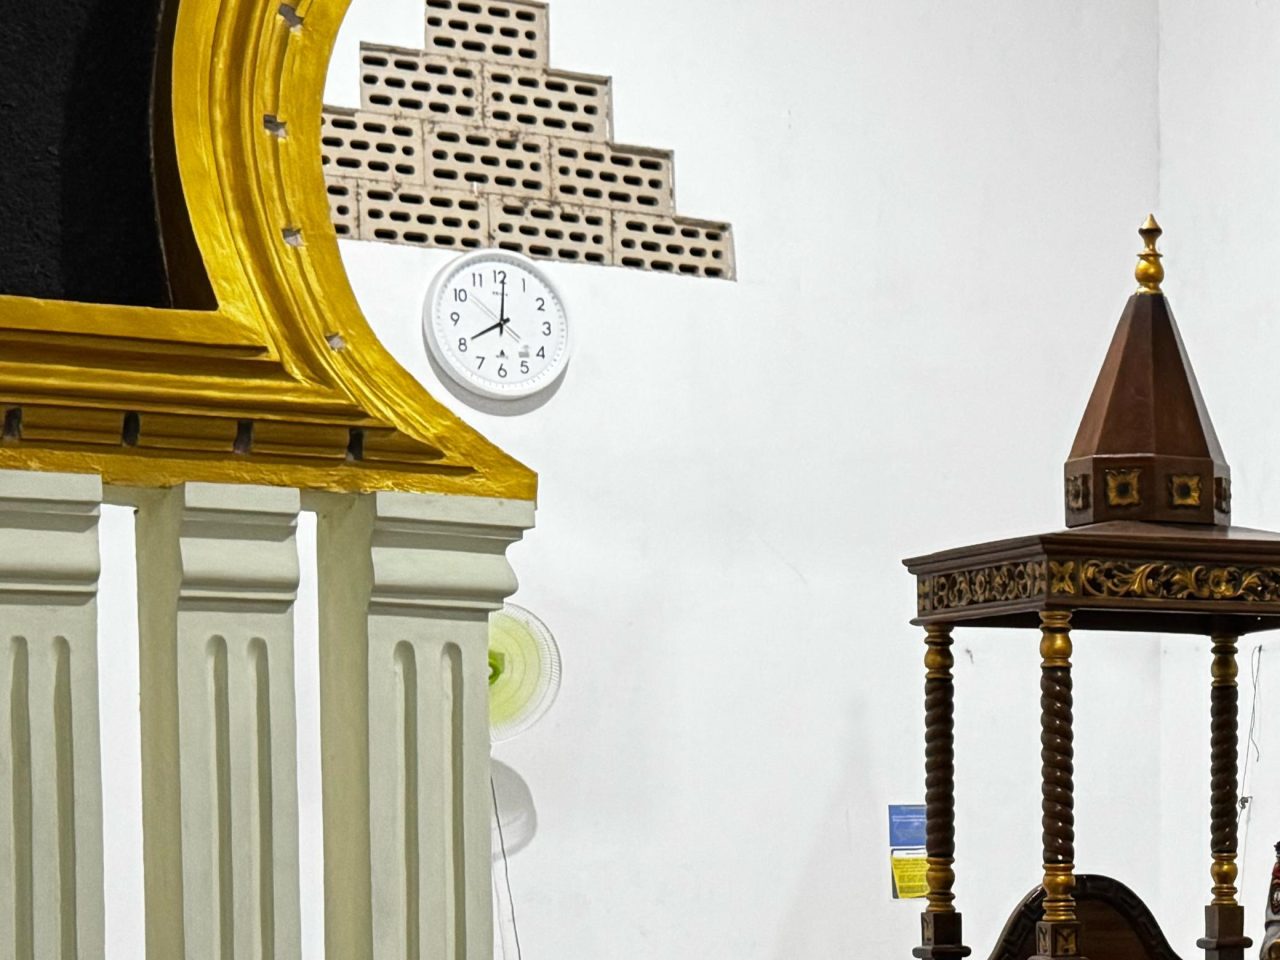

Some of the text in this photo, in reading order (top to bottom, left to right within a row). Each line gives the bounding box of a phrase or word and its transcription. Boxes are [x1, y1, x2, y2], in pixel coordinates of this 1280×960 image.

[472, 272, 483, 288] 11
[493, 270, 507, 285] 12
[522, 278, 526, 293] 1
[453, 288, 468, 302] 10
[535, 297, 546, 312] 2
[450, 311, 460, 326] 9
[542, 321, 552, 336] 3
[458, 337, 468, 353] 8
[536, 345, 546, 360] 4
[475, 355, 486, 370] 7
[520, 360, 530, 374] 5
[497, 363, 508, 378] 6
